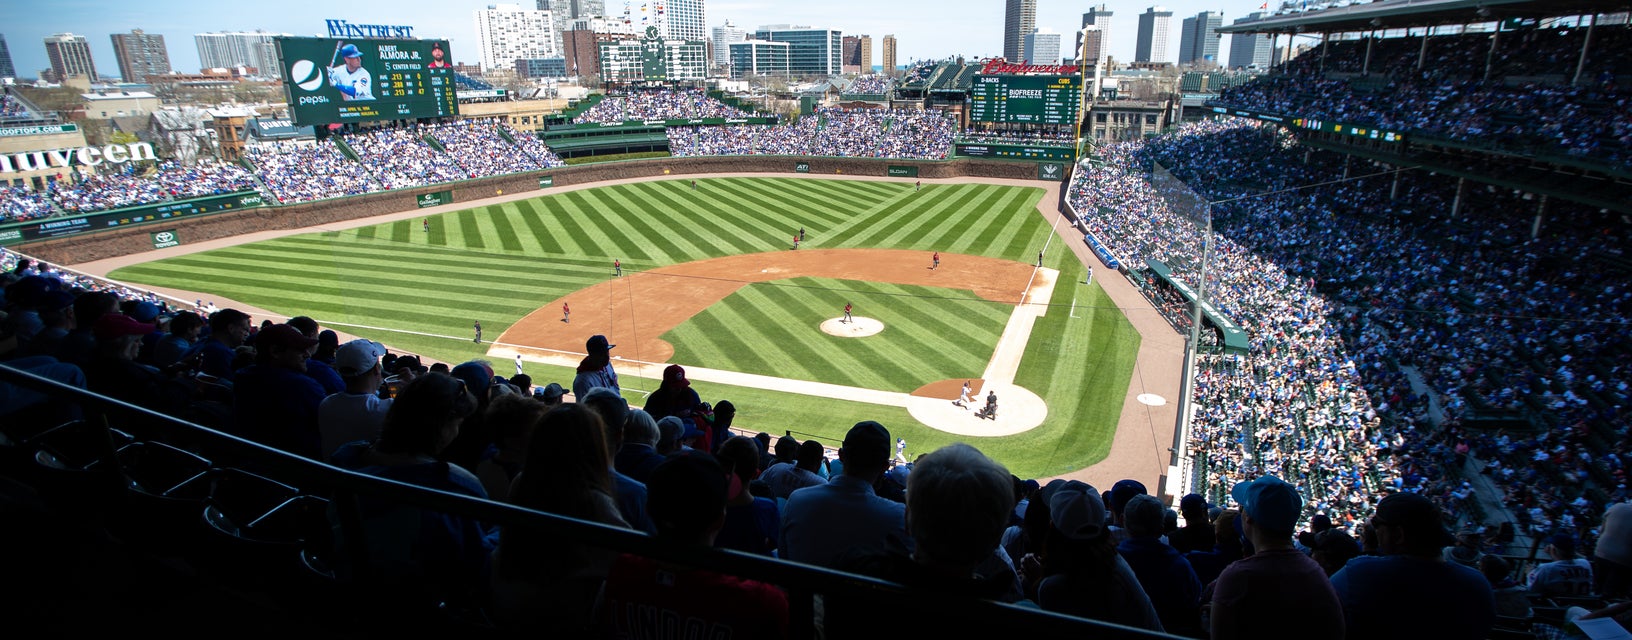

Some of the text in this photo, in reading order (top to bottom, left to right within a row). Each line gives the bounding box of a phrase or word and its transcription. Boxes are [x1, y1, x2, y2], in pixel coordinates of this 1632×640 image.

[326, 19, 414, 39] WINTRUST
[380, 51, 422, 60] ALMORA JR.
[385, 61, 391, 71] 5
[980, 57, 1079, 75] Budweiser
[299, 95, 326, 106] pepsi
[0, 126, 62, 136] OOFTOPS.COM
[796, 163, 809, 171] ATI
[240, 196, 261, 207] xfinity
[154, 240, 178, 249] TOYOTA
